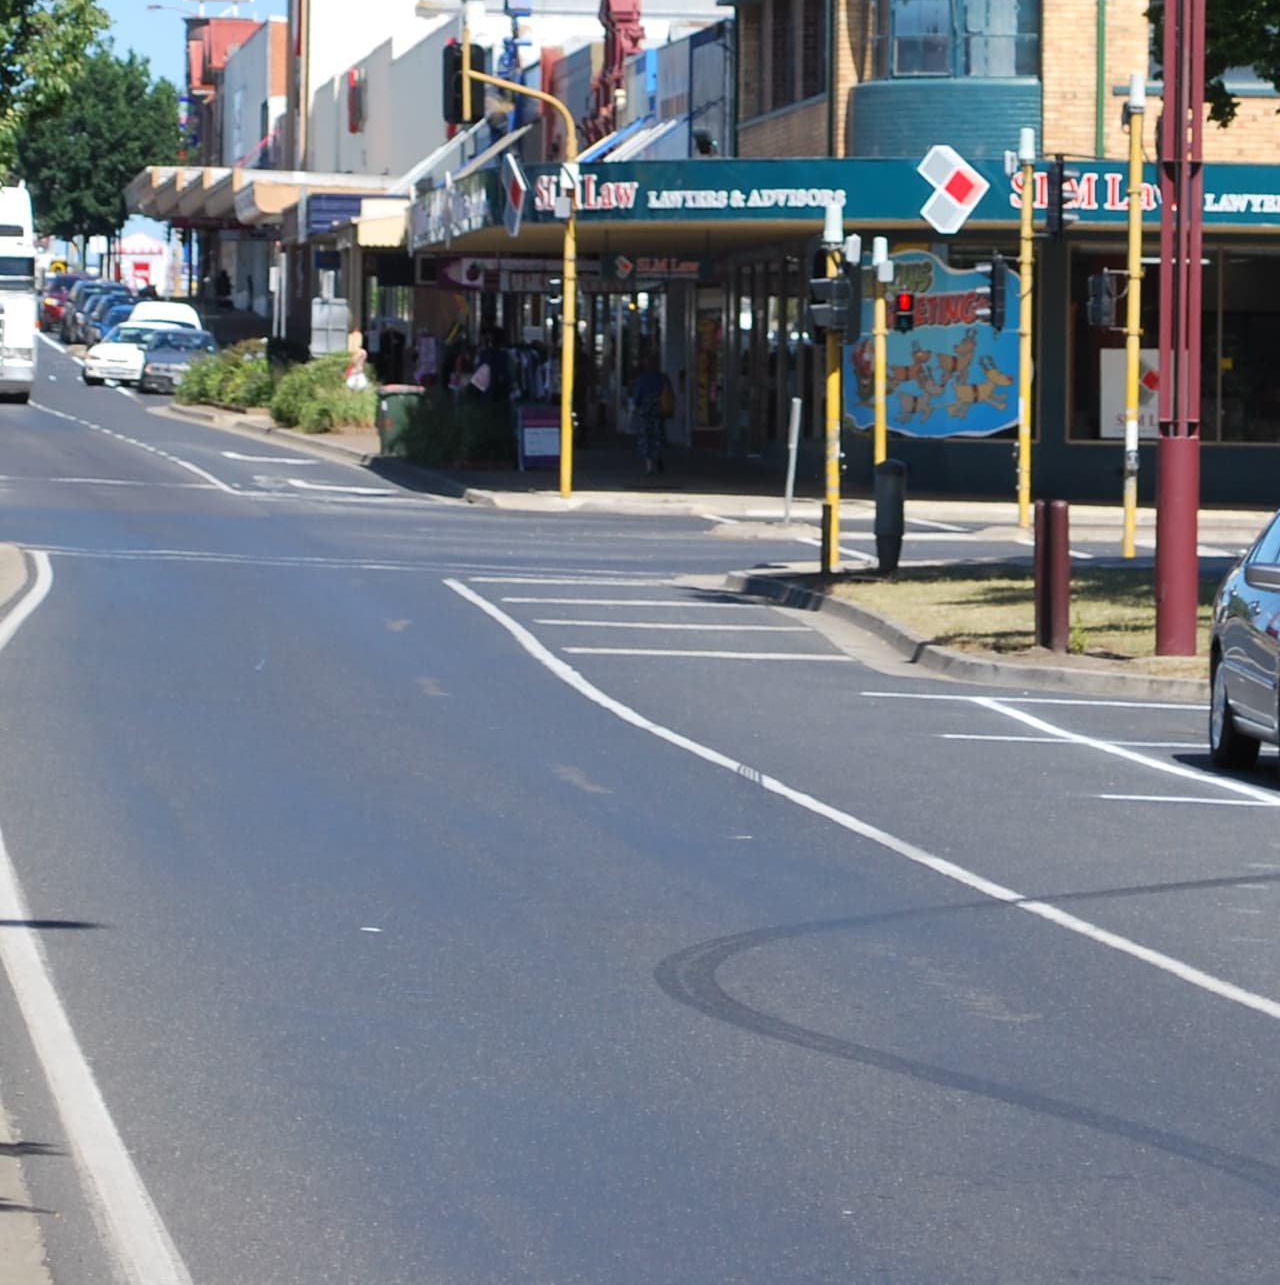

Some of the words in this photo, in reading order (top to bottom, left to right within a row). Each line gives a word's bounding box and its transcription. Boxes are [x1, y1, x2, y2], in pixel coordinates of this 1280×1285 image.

[584, 174, 638, 209] Law
[647, 190, 728, 209] LAWYERS
[730, 189, 747, 207] &
[747, 188, 847, 207] ADVISORS
[1103, 172, 1166, 214] La
[670, 257, 701, 272] Law
